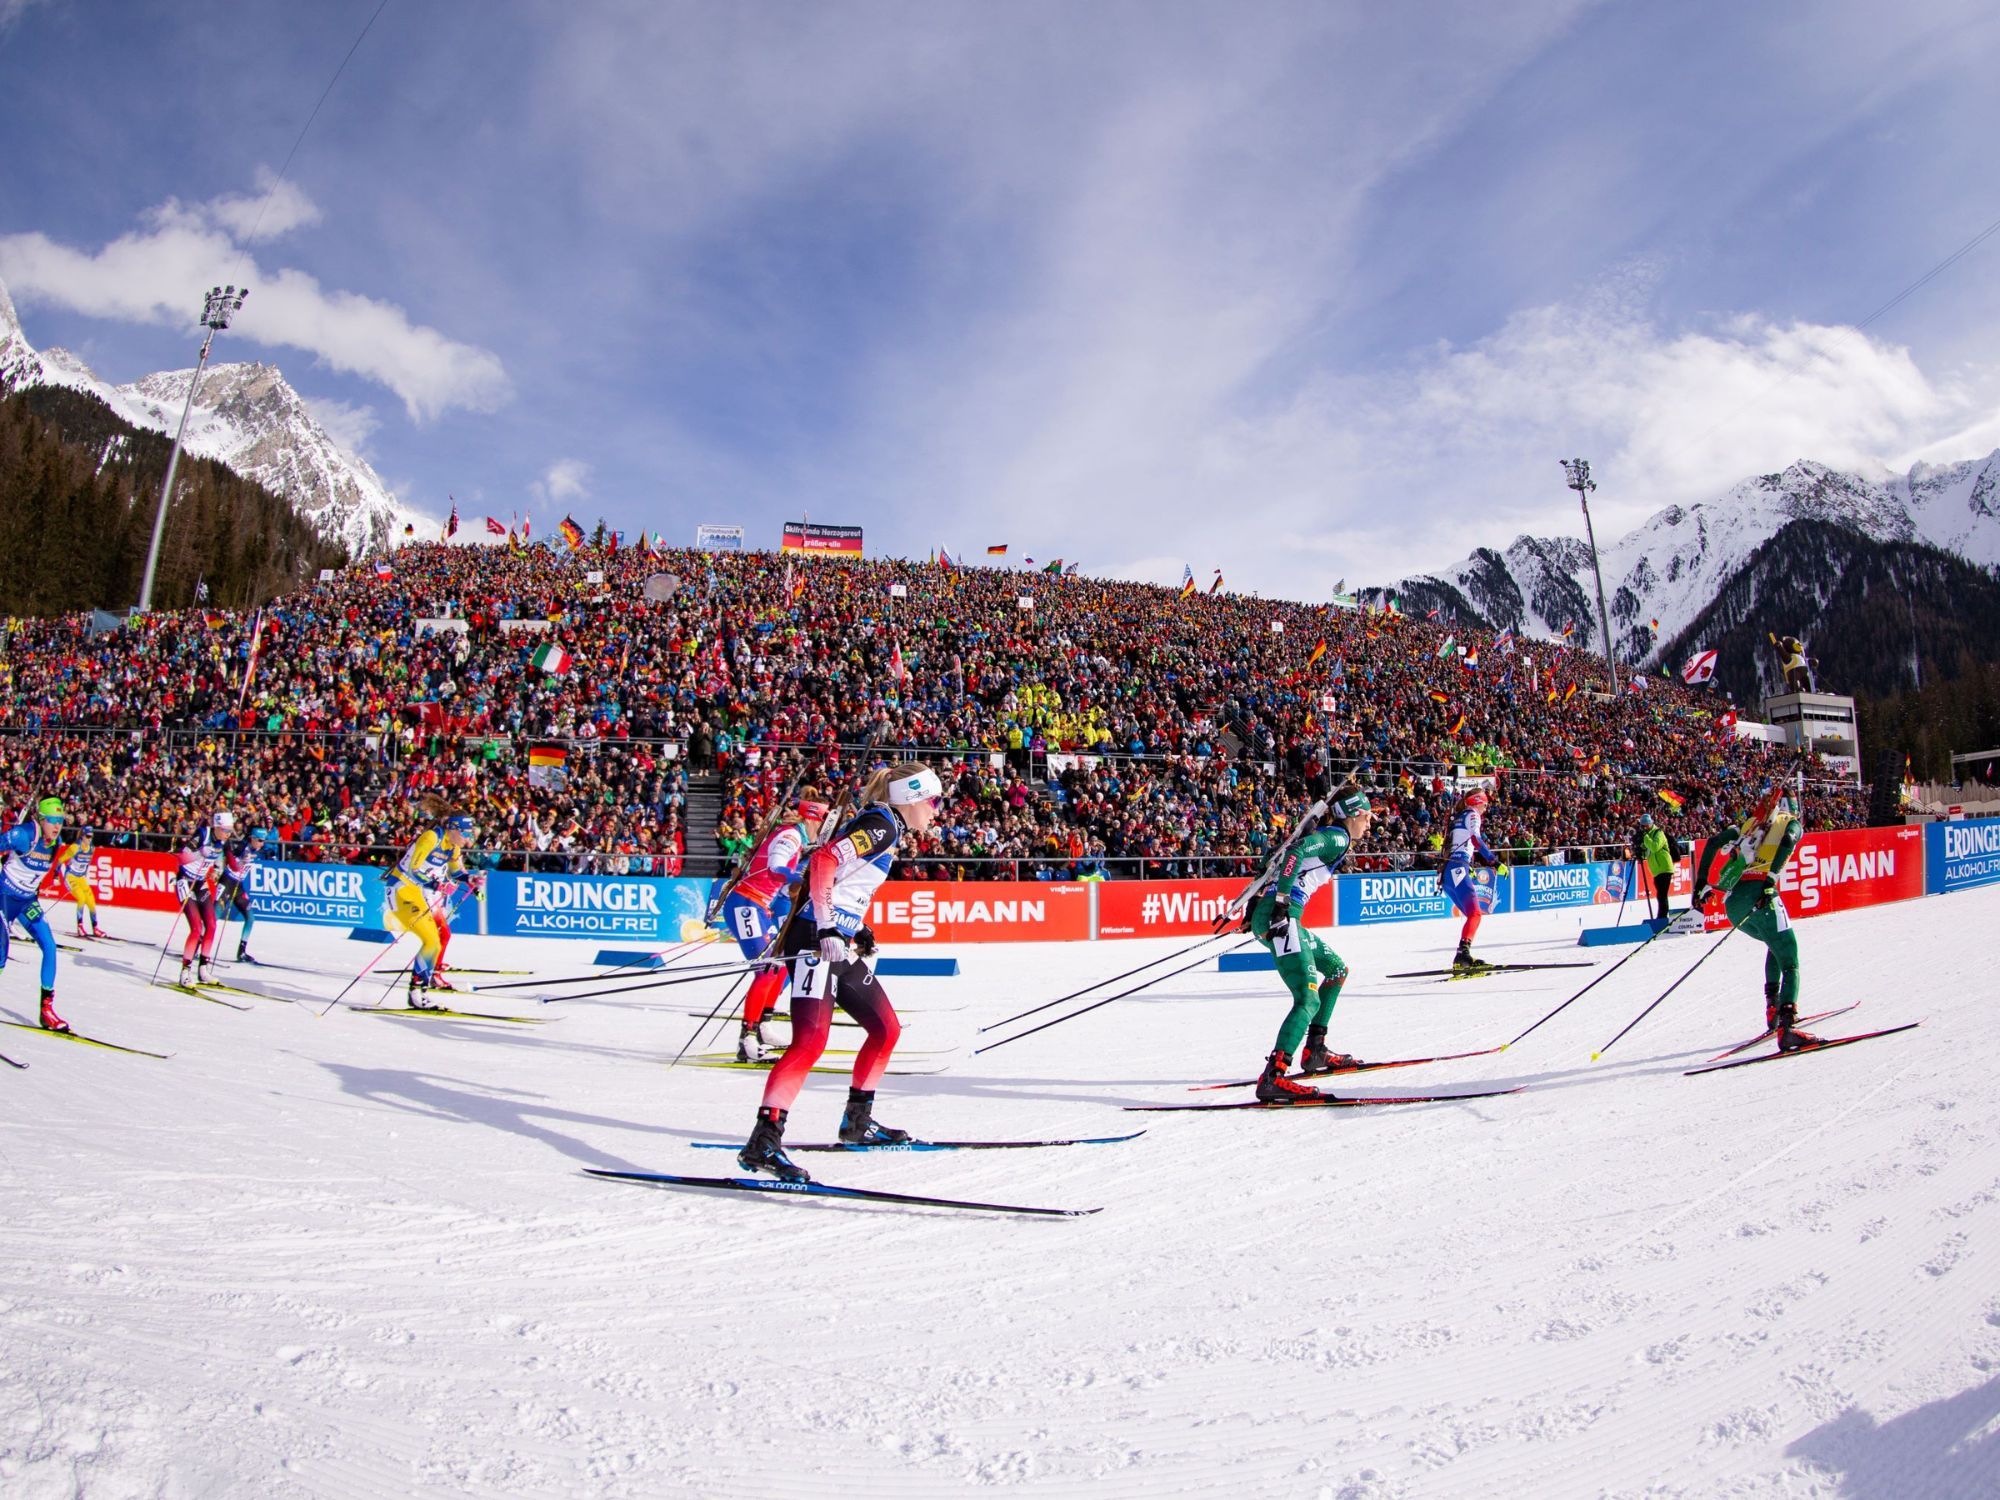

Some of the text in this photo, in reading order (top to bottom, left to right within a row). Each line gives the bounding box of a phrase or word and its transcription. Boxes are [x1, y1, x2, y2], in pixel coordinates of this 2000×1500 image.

[784, 525, 820, 535] Skifrende
[1944, 824, 2000, 860] ERDINGE
[86, 856, 177, 901] ESSMAN
[1529, 868, 1591, 892] ERDINGER
[1779, 844, 1895, 910] ESSMANN
[1944, 858, 2000, 880] ALKOHOLFR
[249, 863, 366, 902] ERDINGER
[516, 876, 661, 915] ERDINGER
[1529, 889, 1590, 904] ALKOHOLFREI
[250, 898, 365, 918] ALKOHOLFREI
[873, 890, 1046, 938] IESSMANN
[1360, 901, 1445, 917] ALKOHOLFREI
[516, 913, 658, 931] ALKOHOLFREI
[744, 919, 754, 938] 5
[801, 968, 815, 996] 4
[758, 1180, 808, 1191] salomon
